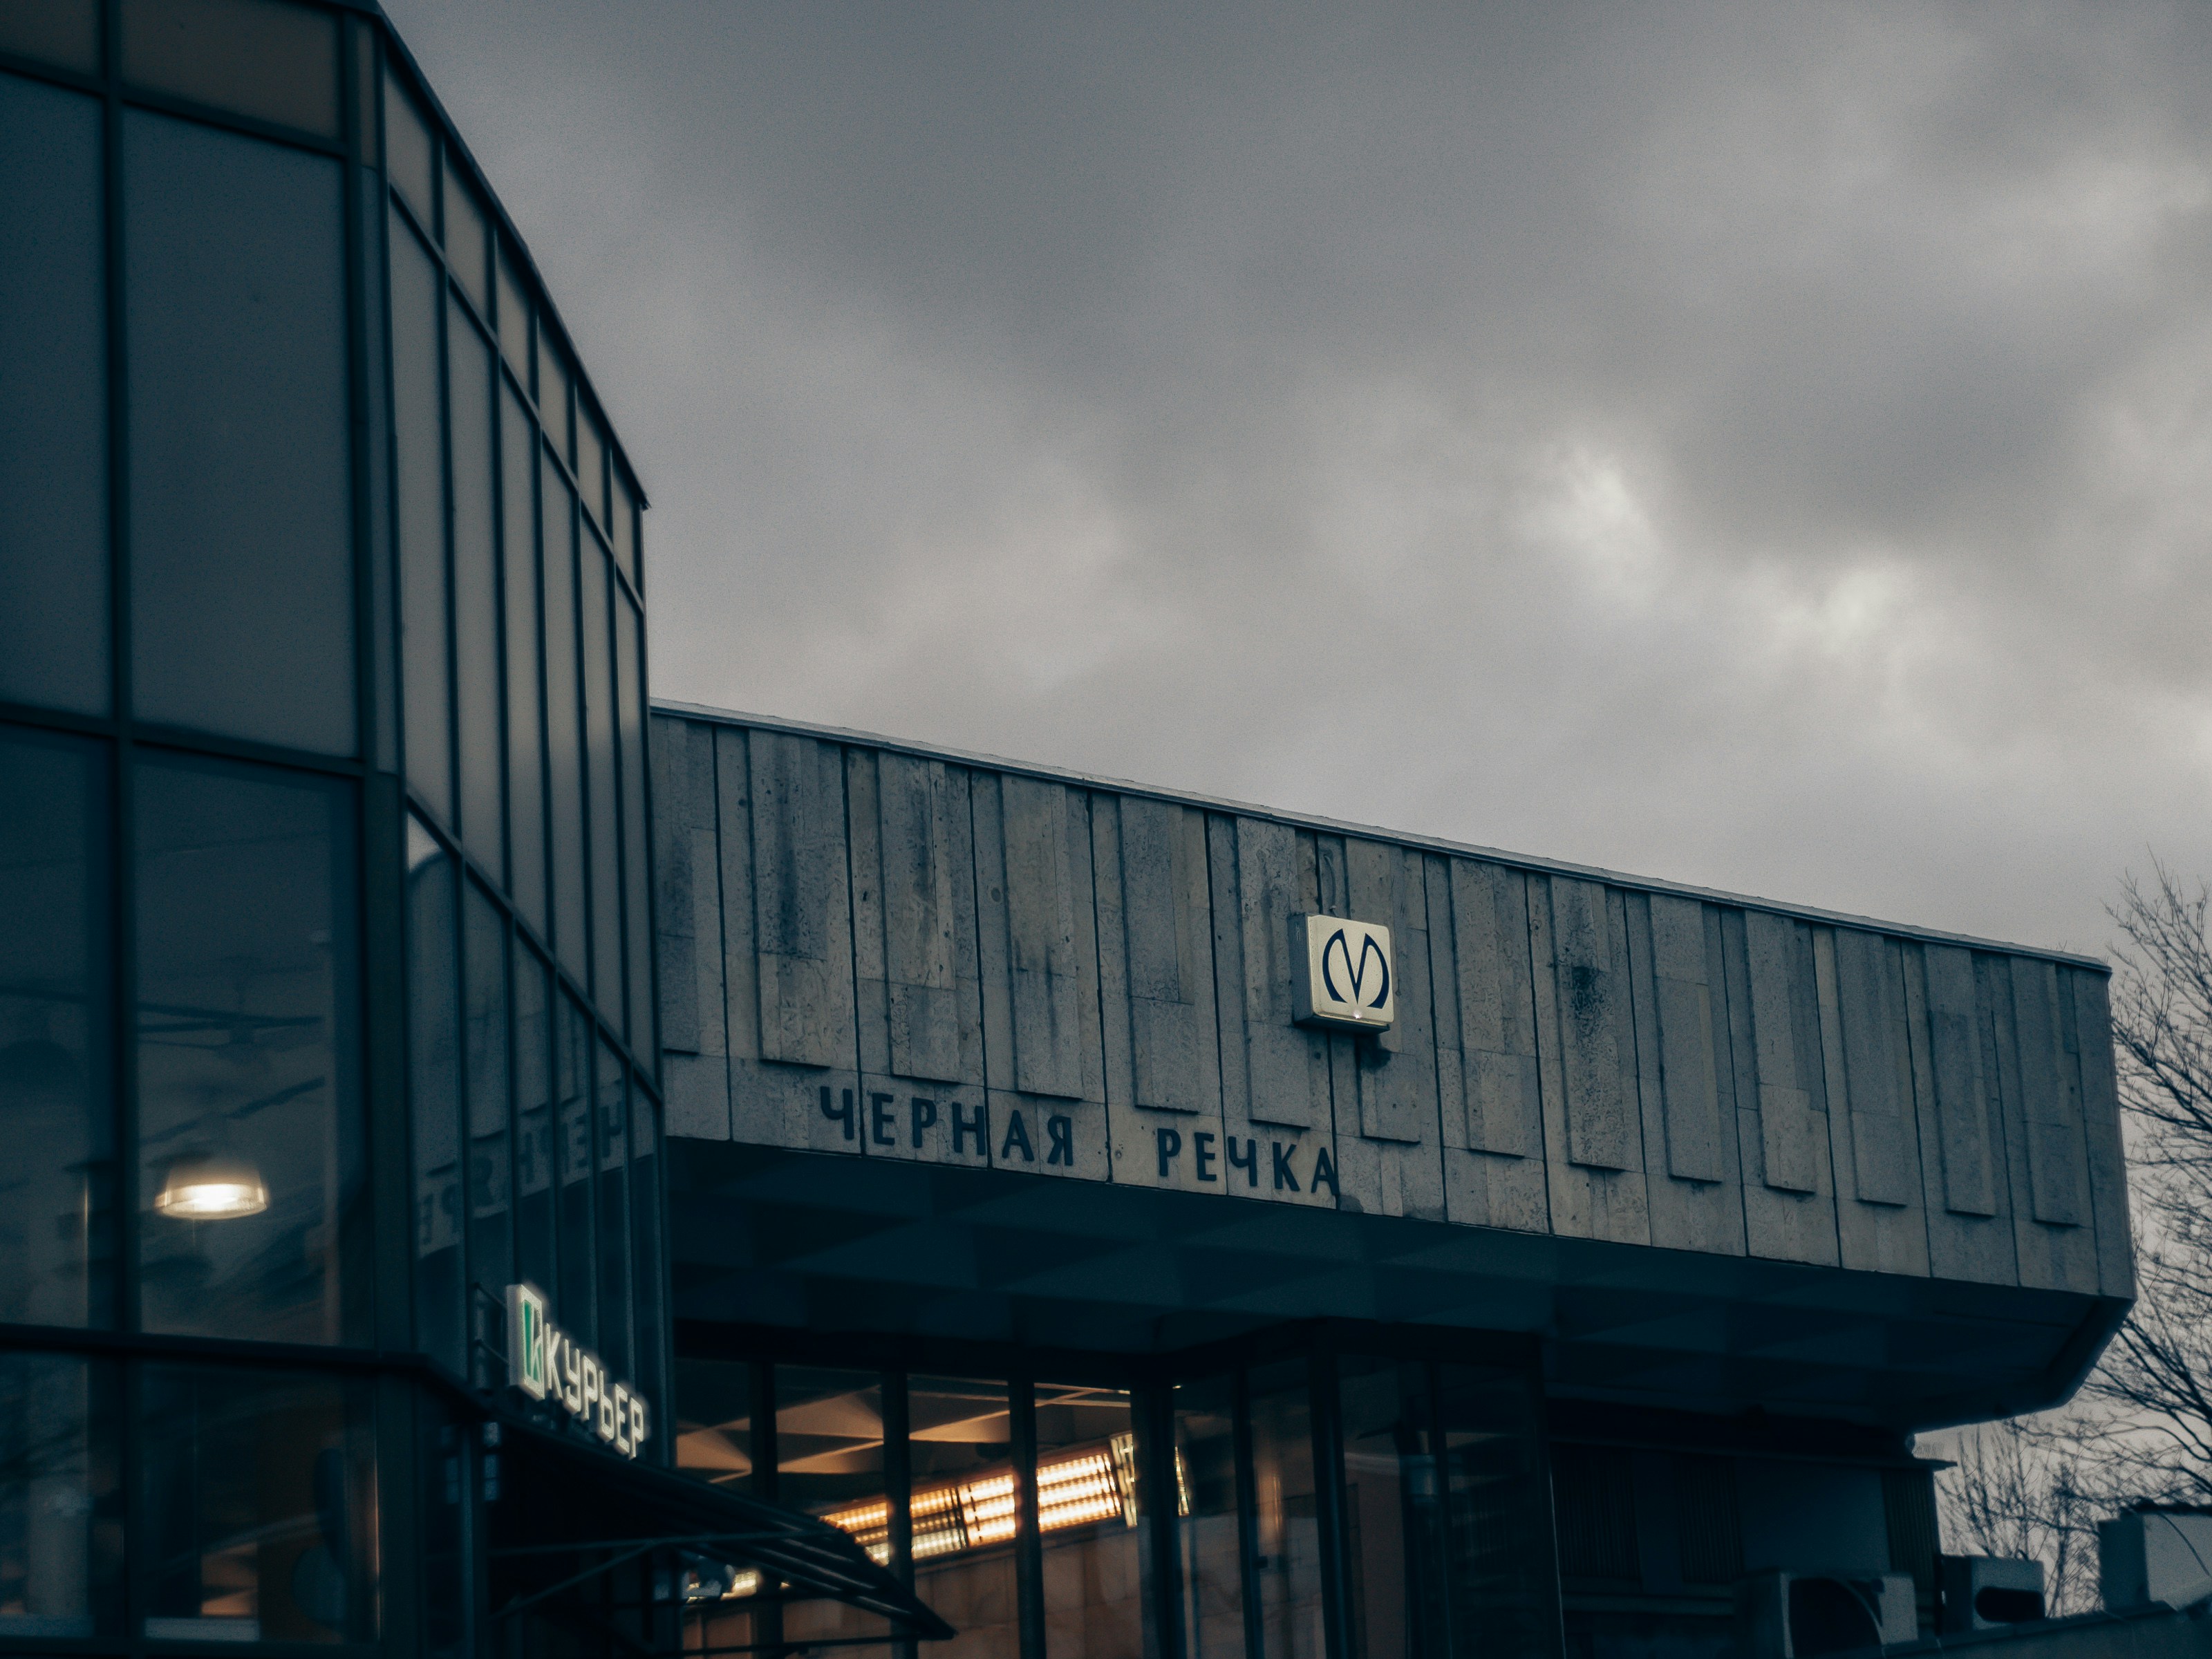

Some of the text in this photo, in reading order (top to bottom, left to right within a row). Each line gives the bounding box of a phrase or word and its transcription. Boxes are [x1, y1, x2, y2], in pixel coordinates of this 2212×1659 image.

[820, 1085, 1340, 1197] ЧЕРНАЯ РЕЧКА
[545, 1322, 645, 1460] КУРЬЕР
